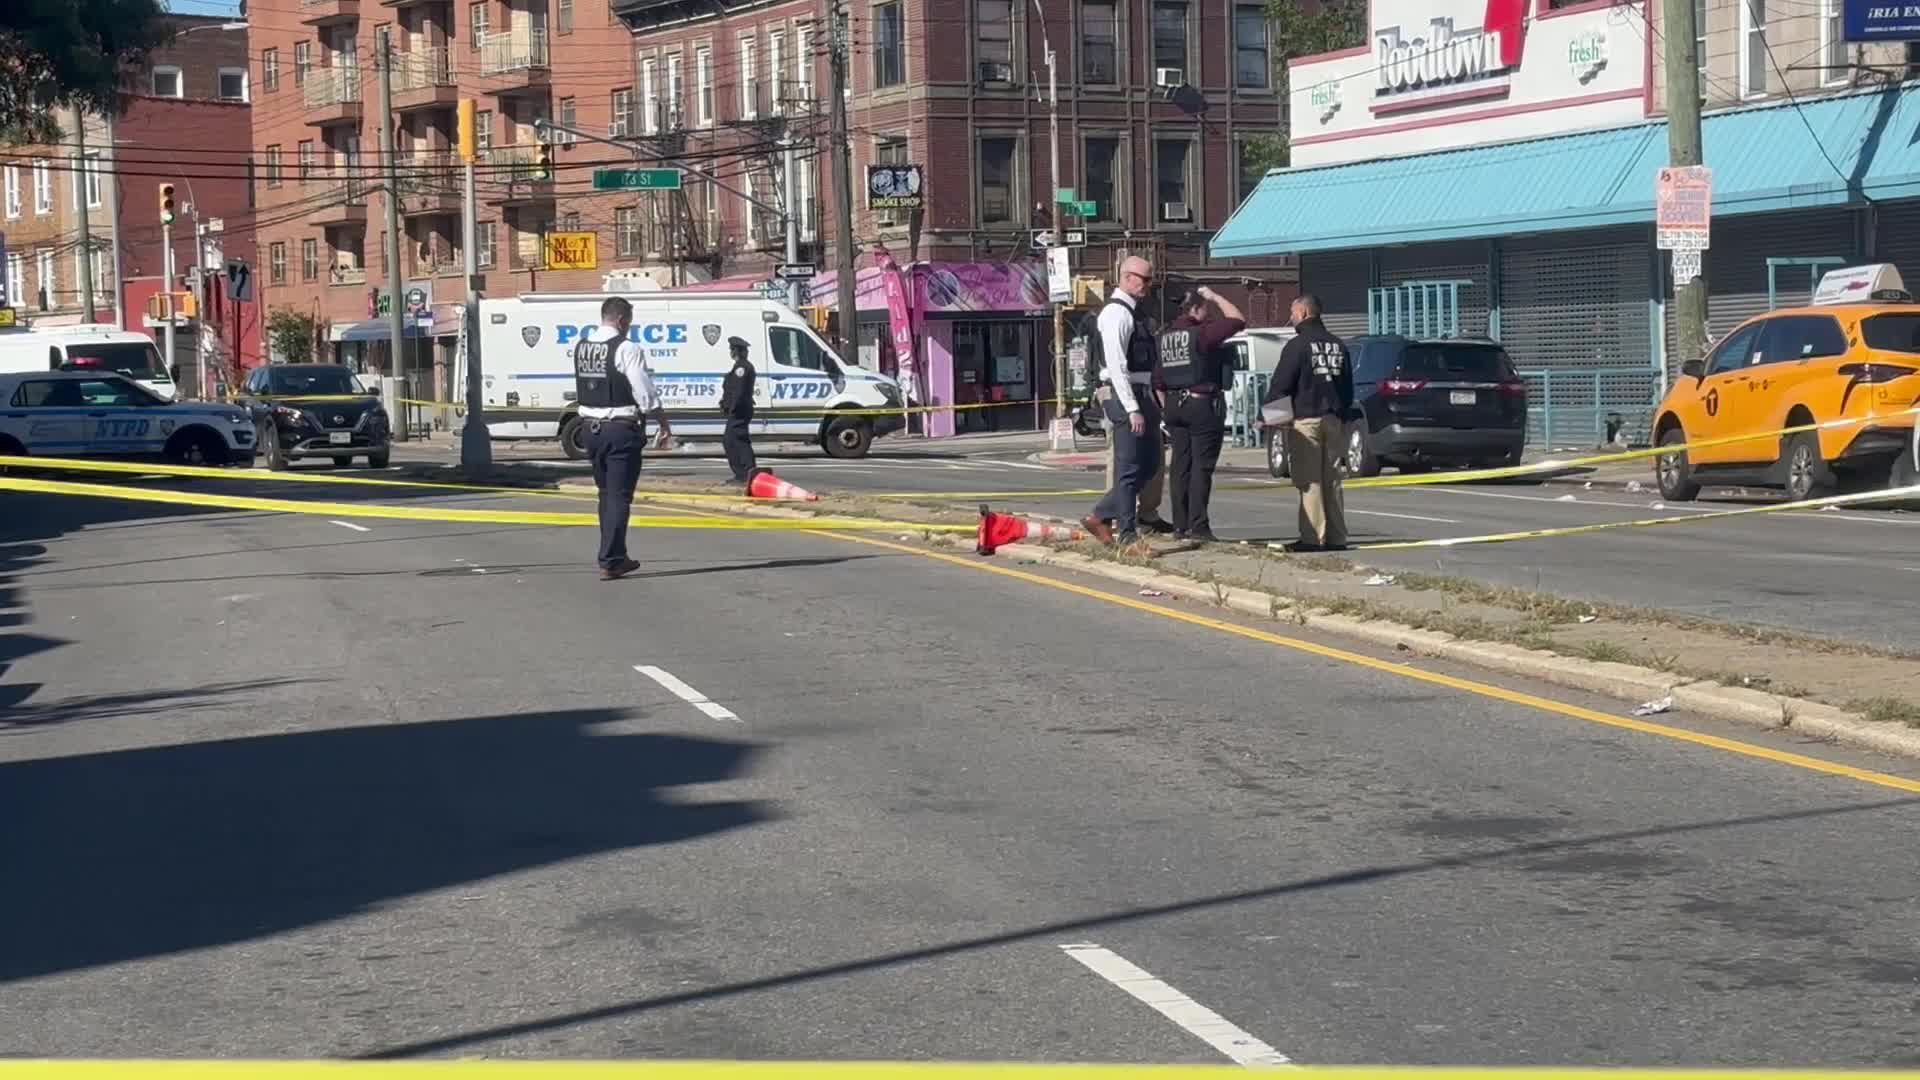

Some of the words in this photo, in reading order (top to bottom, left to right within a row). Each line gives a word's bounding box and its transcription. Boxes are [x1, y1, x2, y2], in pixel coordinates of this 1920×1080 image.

[1376, 23, 1503, 88] Foodtown
[1569, 38, 1601, 64] fresh
[1311, 83, 1335, 105] fresh
[640, 173, 651, 184] St
[871, 198, 898, 208] SMOKE
[900, 198, 920, 208] SHOP
[554, 250, 586, 263] DELI
[556, 324, 688, 345] POICE
[1161, 331, 1189, 348] NYPD
[577, 343, 609, 360] NYPD
[651, 348, 678, 358] UNIT
[1161, 346, 1190, 361] POLICE
[577, 360, 607, 373] POLICE
[773, 383, 832, 399] NYPD
[96, 418, 151, 438] NYPD
